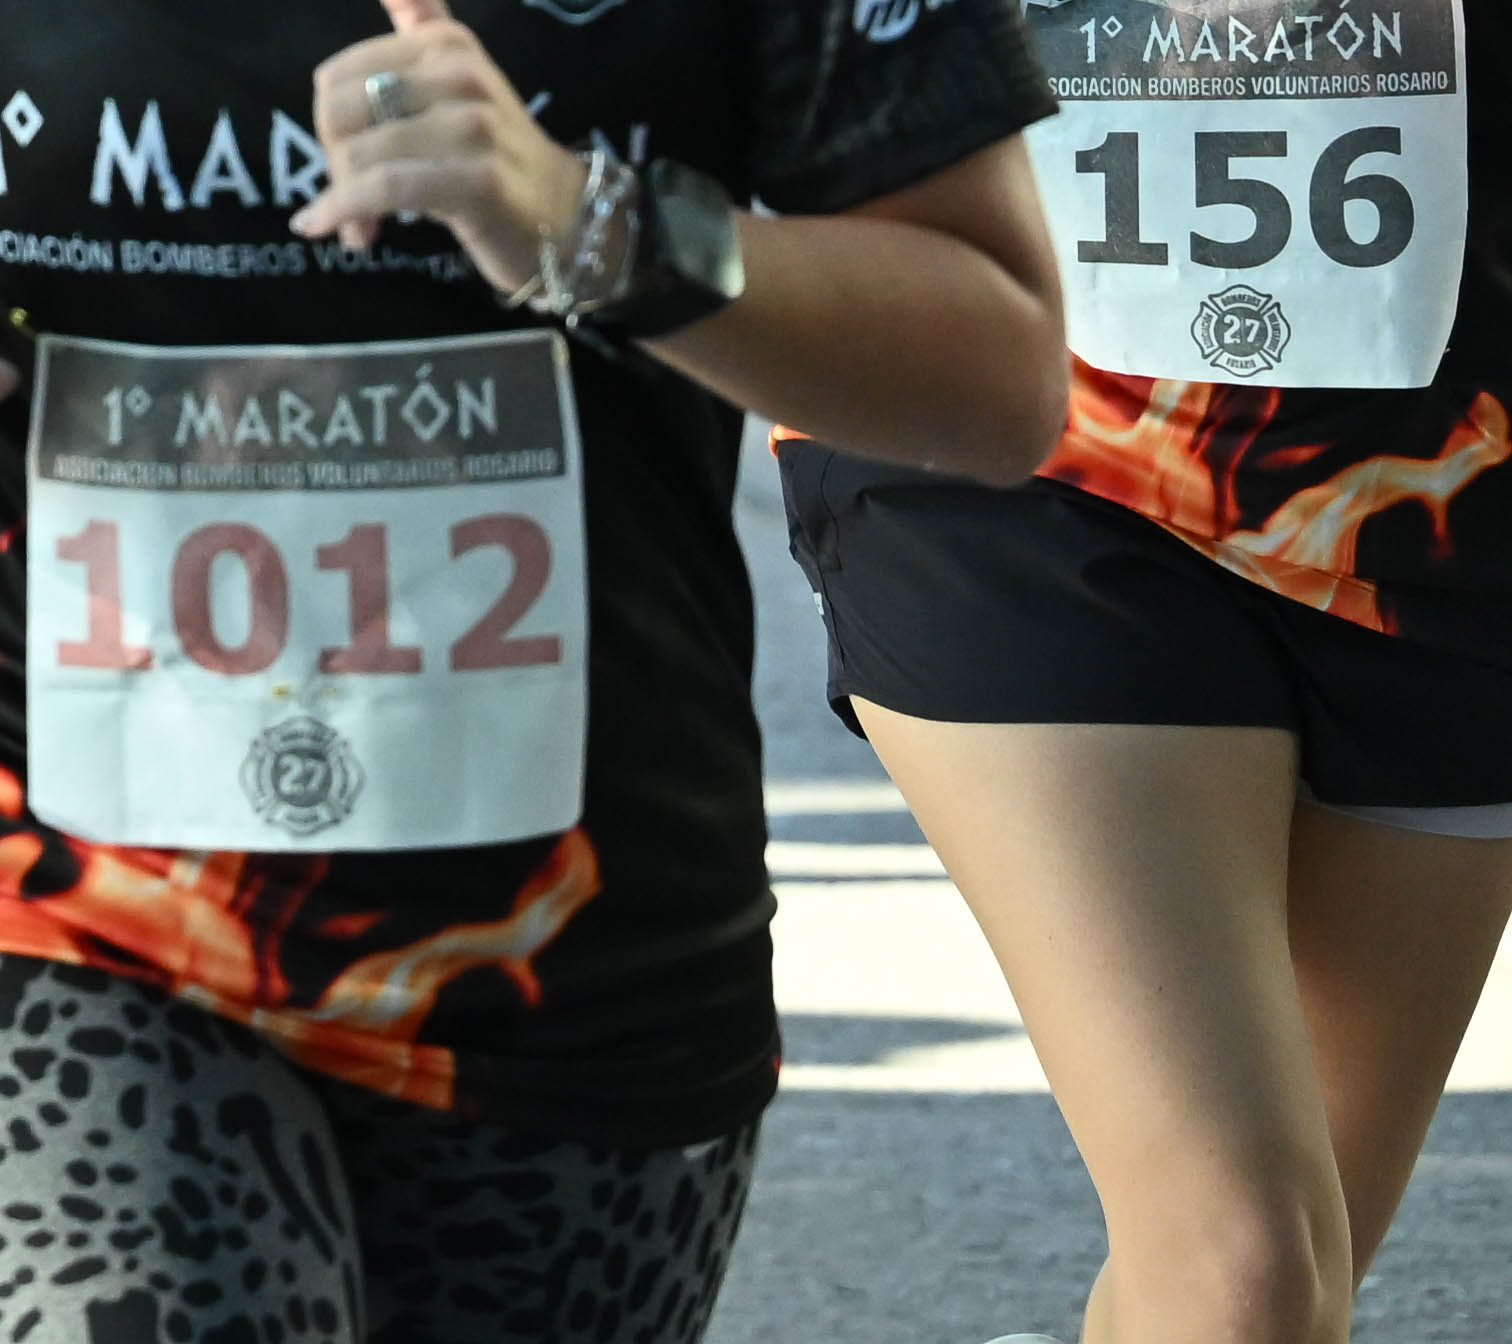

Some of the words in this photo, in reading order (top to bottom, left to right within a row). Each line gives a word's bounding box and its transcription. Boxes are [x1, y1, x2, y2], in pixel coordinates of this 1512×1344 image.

[1047, 72, 1142, 97] SOCIACIÓN
[1148, 75, 1246, 96] BOMBEROS
[1251, 73, 1371, 94] VOLUNTARIOS
[1376, 70, 1449, 92] ROSARIO
[1074, 125, 1415, 270] 156
[119, 239, 306, 277] BOMBEROS
[1224, 314, 1260, 345] 27
[174, 363, 499, 450] MARATÓN
[55, 512, 562, 676] 1012
[279, 754, 324, 795] 27
